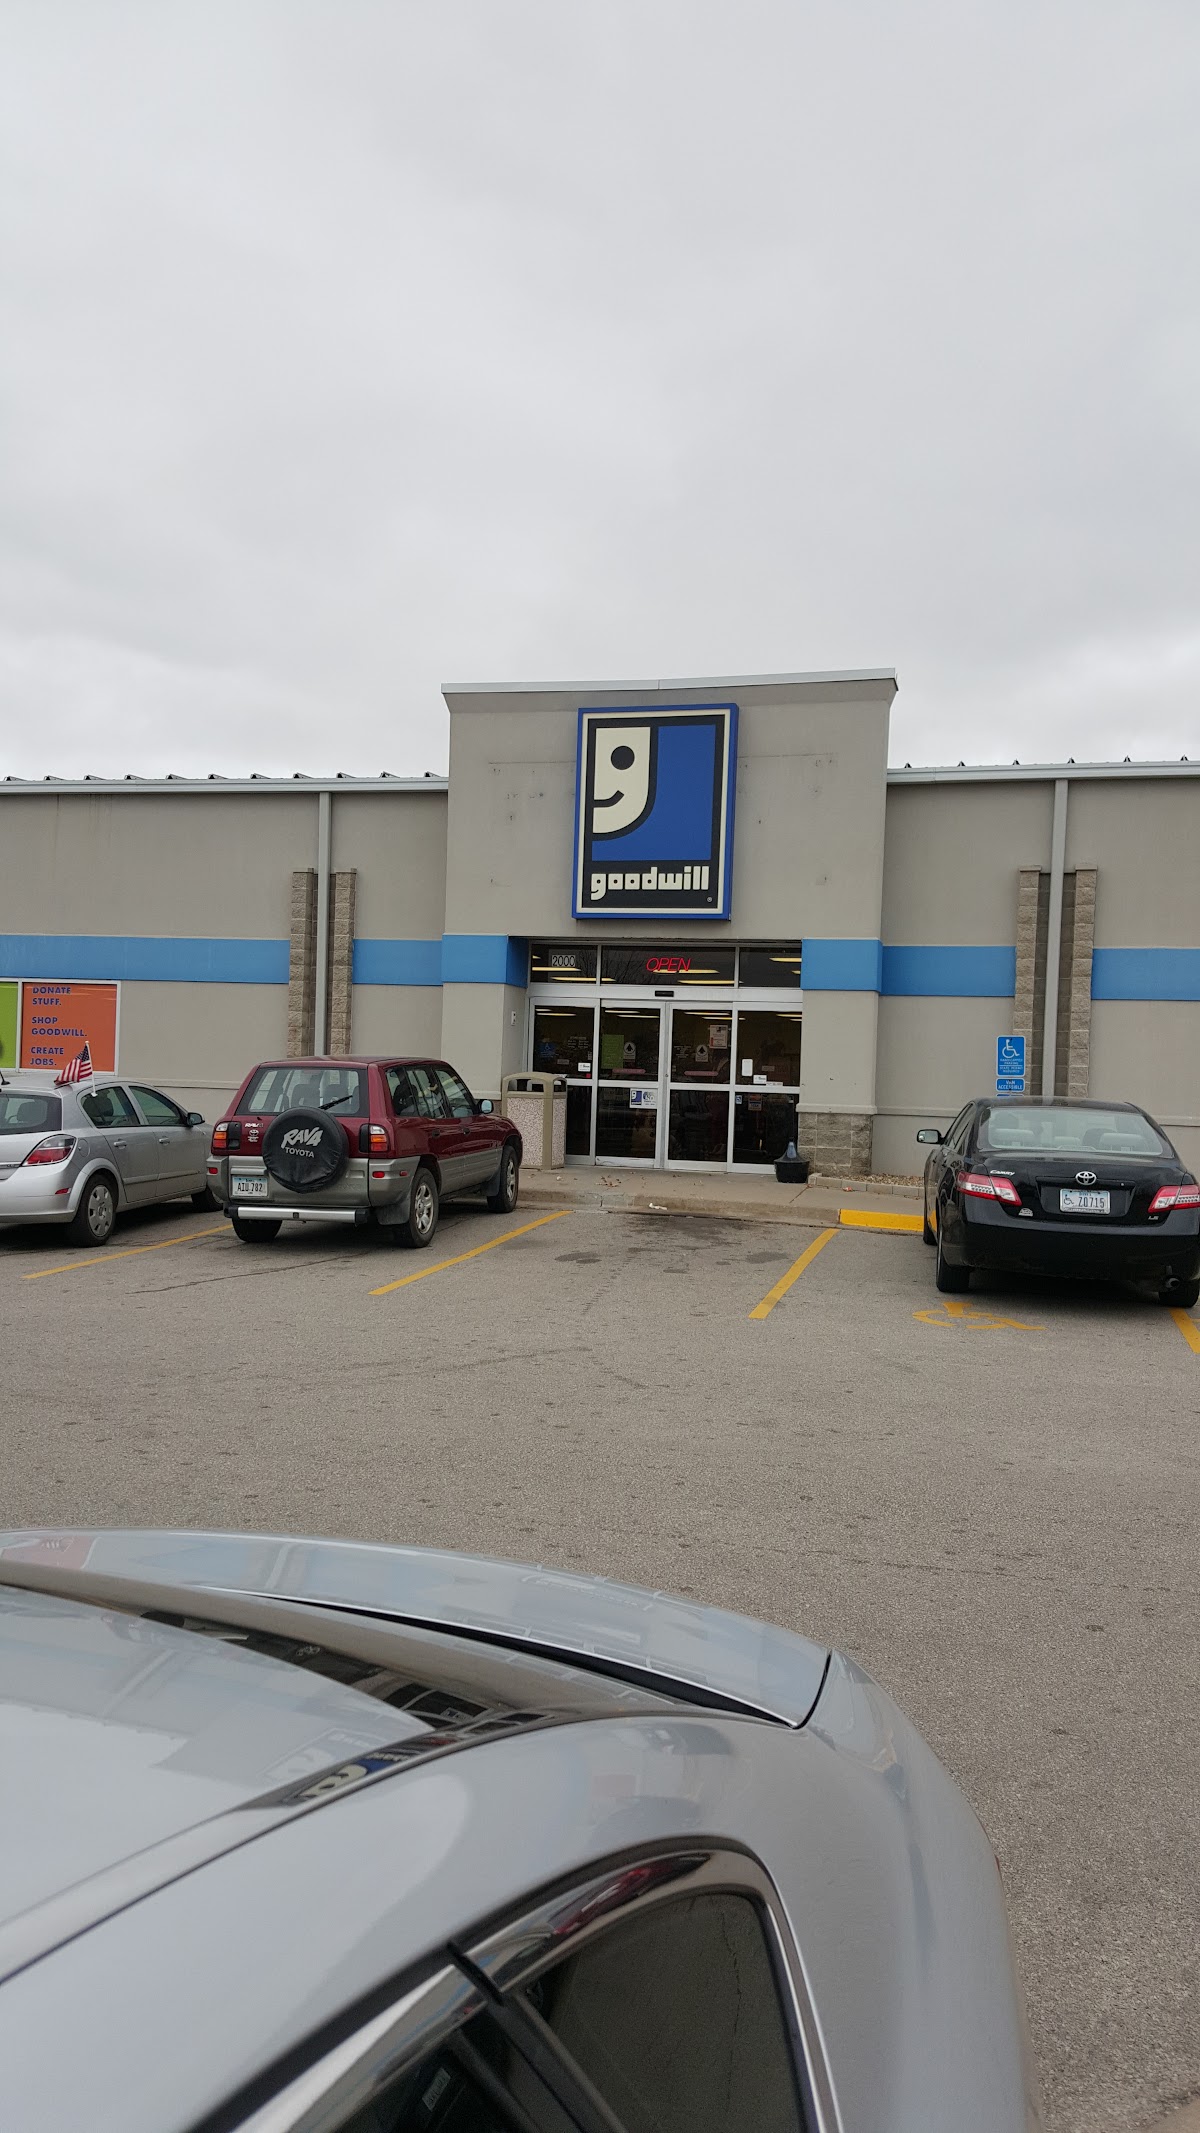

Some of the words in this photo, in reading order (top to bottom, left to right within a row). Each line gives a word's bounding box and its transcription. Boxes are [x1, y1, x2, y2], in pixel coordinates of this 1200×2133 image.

[590, 865, 710, 901] goodwill
[551, 955, 576, 967] 2000
[645, 957, 692, 972] OPEN
[32, 1028, 87, 1036] GOODWILL.
[281, 1126, 324, 1149] RAV4
[285, 1146, 315, 1158] TOYOTA
[250, 1182, 263, 1192] 782
